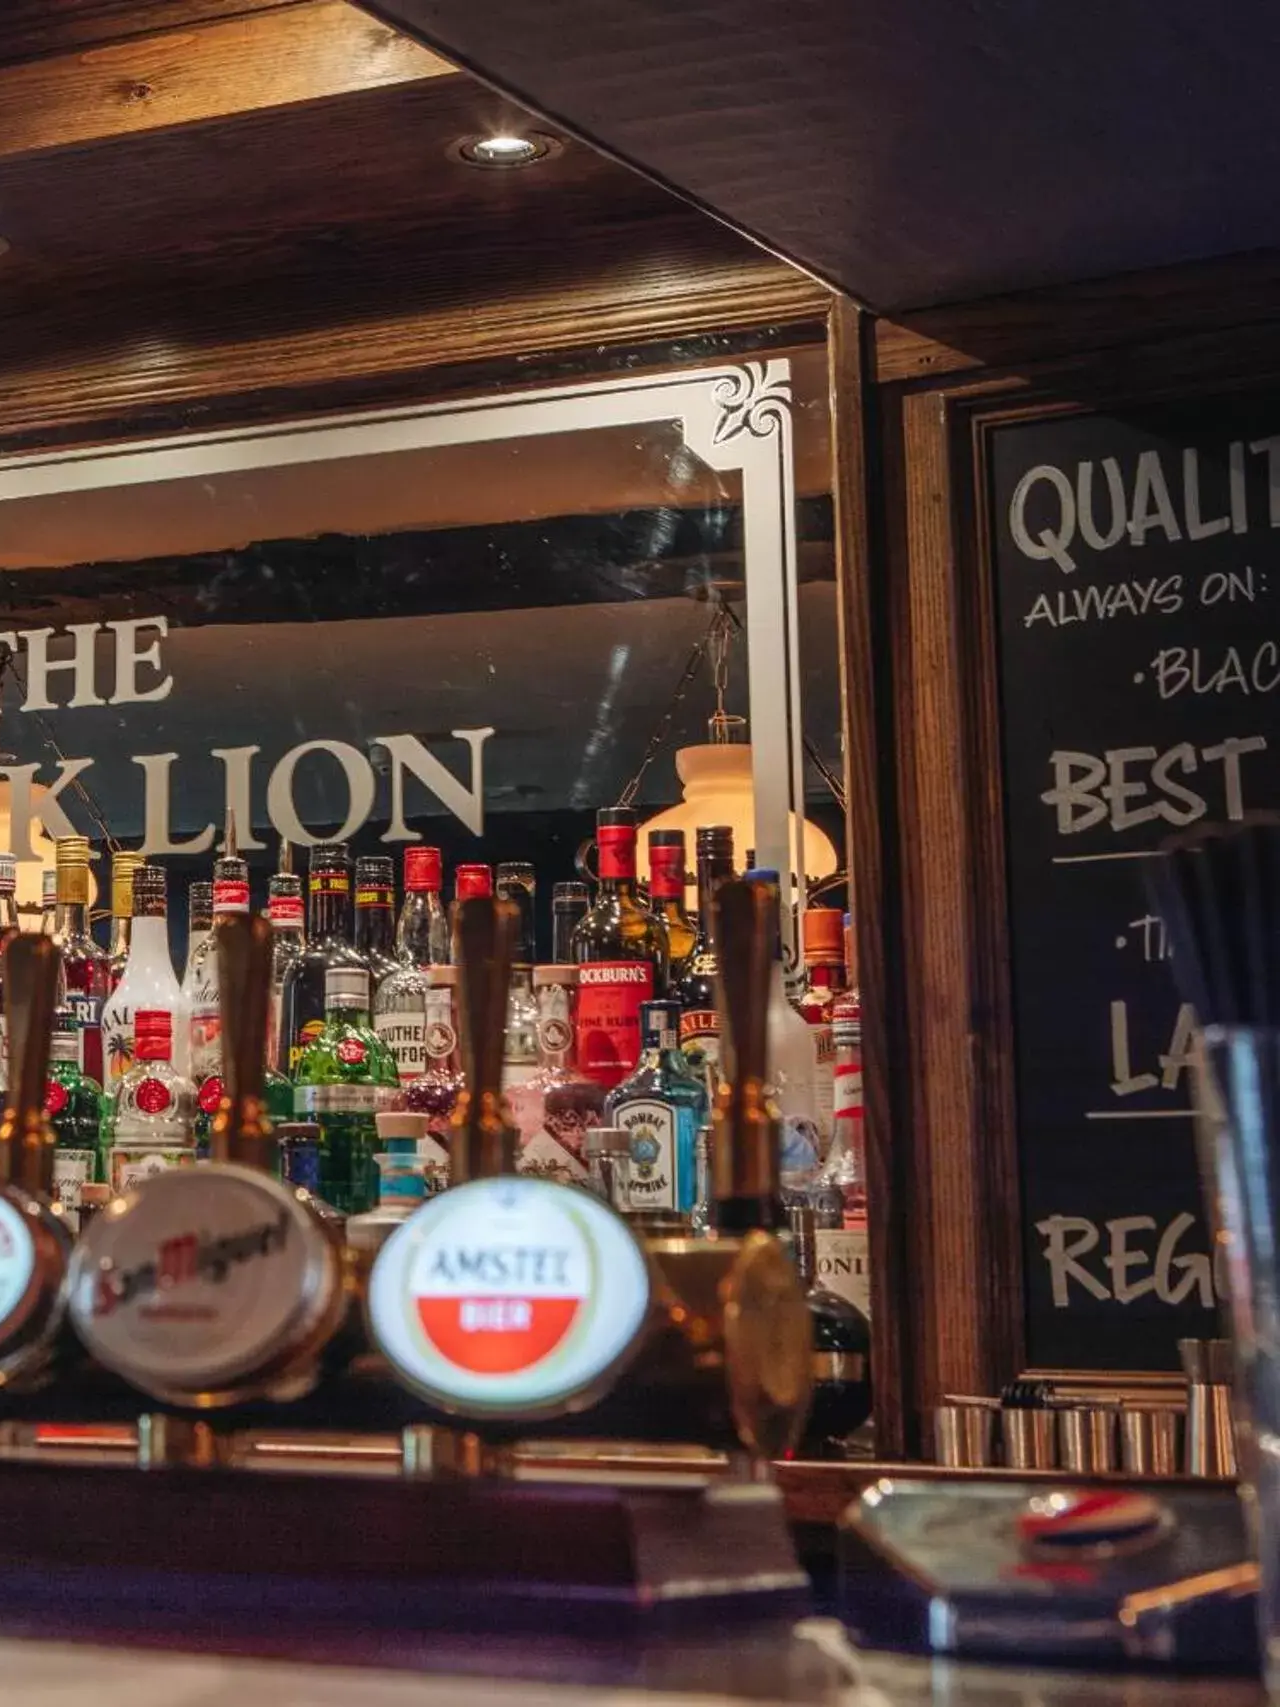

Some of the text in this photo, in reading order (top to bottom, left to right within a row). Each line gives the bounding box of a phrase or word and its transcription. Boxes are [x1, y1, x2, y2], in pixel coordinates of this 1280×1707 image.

[1024, 566, 1267, 628] ALWAYS ON:
[131, 726, 496, 857] LION
[1041, 736, 1267, 835] BEST
[623, 1112, 666, 1132] BOMBAY
[429, 1247, 570, 1288] AMSTEL
